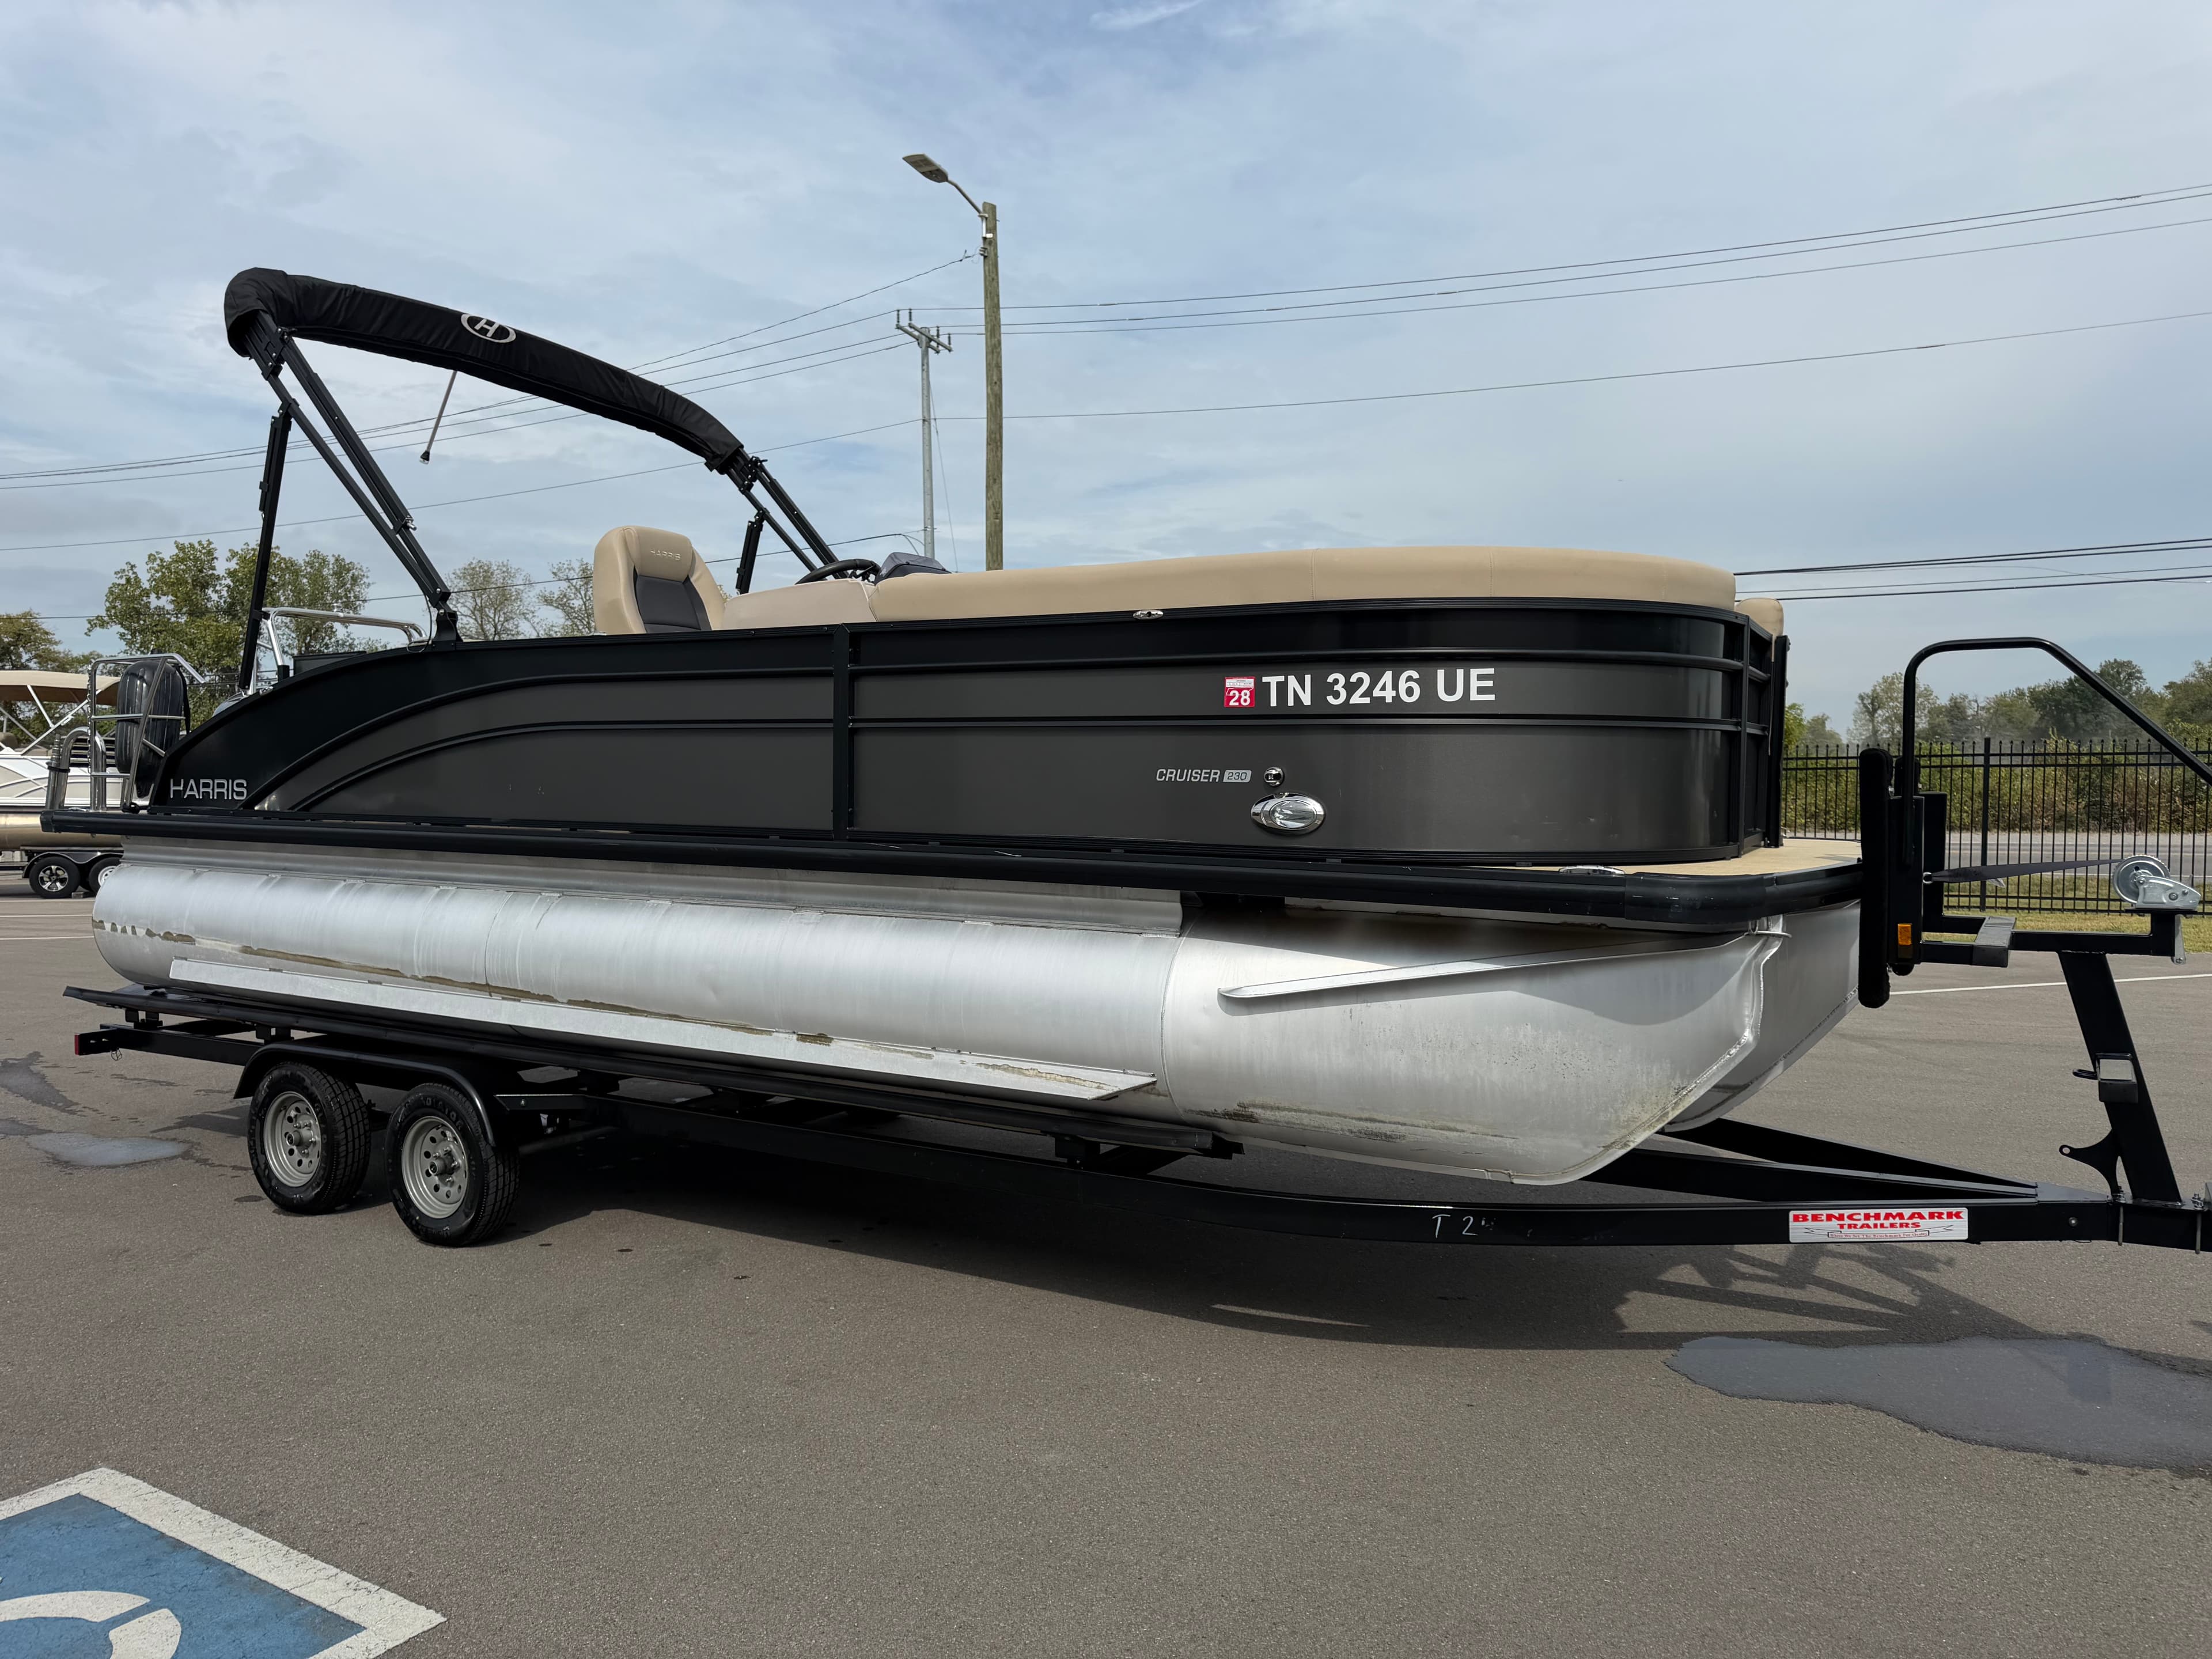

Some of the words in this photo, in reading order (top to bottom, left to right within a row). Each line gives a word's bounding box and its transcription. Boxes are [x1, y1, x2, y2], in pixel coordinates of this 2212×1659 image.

[1262, 674, 1311, 707] TN
[1326, 670, 1421, 705] 3246
[1437, 668, 1496, 702] UE
[1229, 690, 1251, 706] 28
[1156, 768, 1221, 782] CRUISER
[1228, 772, 1248, 781] 230
[170, 778, 247, 800] HARRIS
[1793, 1211, 1963, 1222] BENCHMARK
